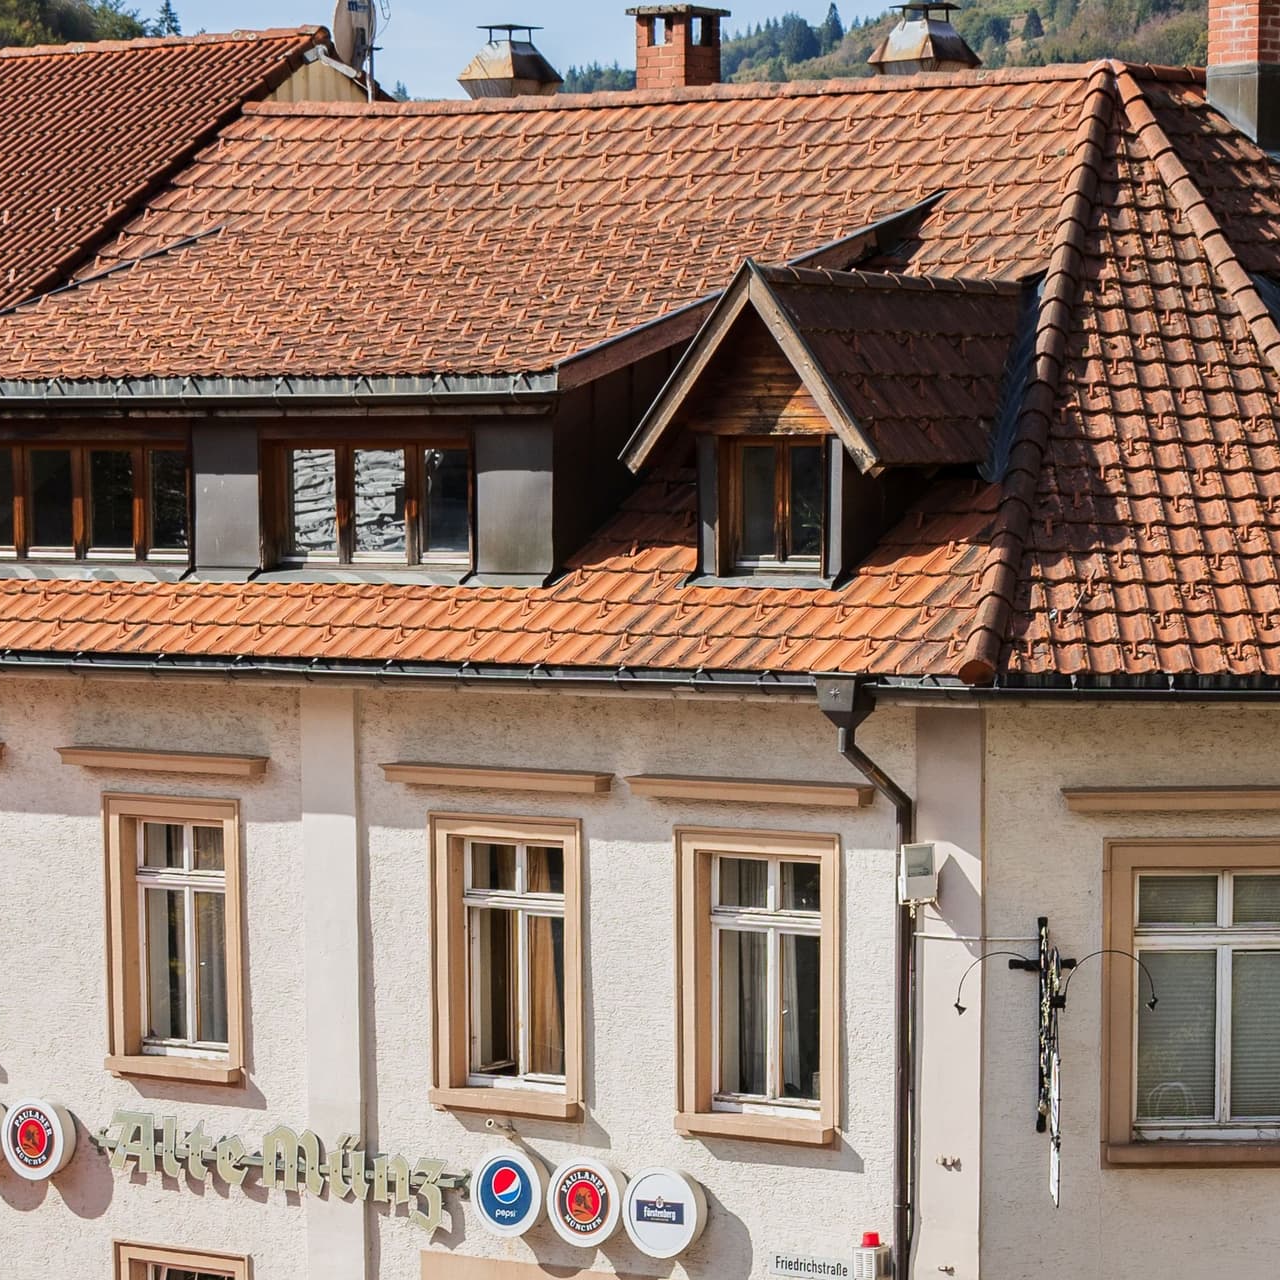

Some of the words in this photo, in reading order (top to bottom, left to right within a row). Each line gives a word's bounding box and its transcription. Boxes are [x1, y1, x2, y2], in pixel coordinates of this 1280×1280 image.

[14, 1109, 53, 1137] PAULANER
[15, 1146, 48, 1166] MÜNCHEN
[110, 1110, 248, 1184] Alte
[263, 1125, 451, 1233] Münz
[560, 1170, 607, 1198] PAULANER
[495, 1208, 517, 1219] pepsi
[563, 1213, 603, 1232] MÜNCHEN
[642, 1206, 676, 1222] Fürstenberg
[775, 1255, 848, 1277] Friedrichstraße
